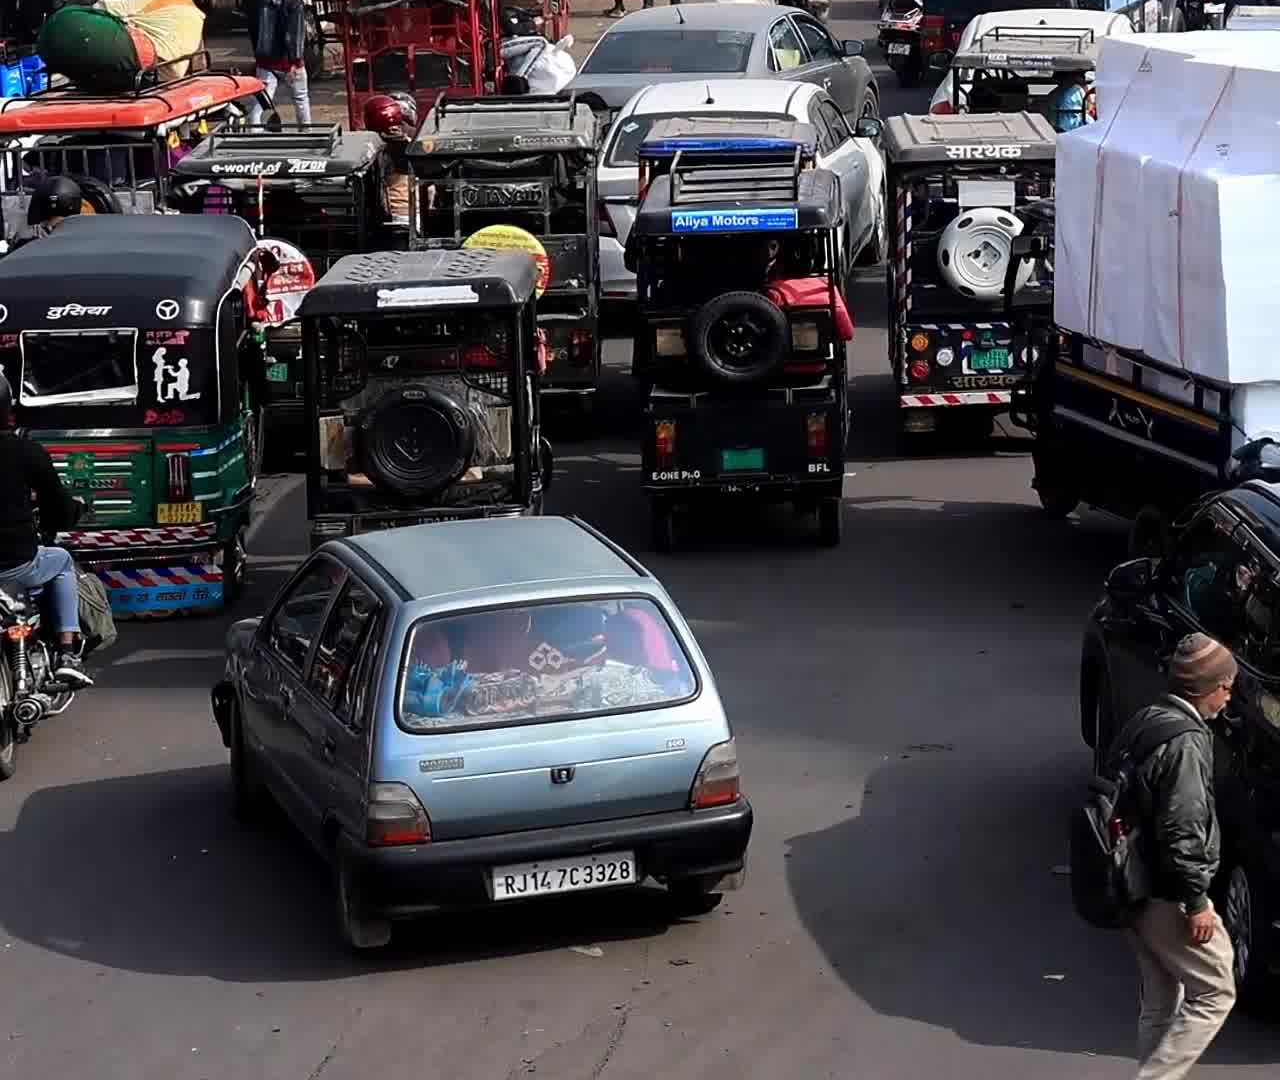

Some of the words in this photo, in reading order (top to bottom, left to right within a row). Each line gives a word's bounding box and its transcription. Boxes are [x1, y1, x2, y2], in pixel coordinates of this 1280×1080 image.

[675, 216, 709, 229] Aliya
[712, 215, 759, 226] Motors
[808, 463, 830, 472] BFL
